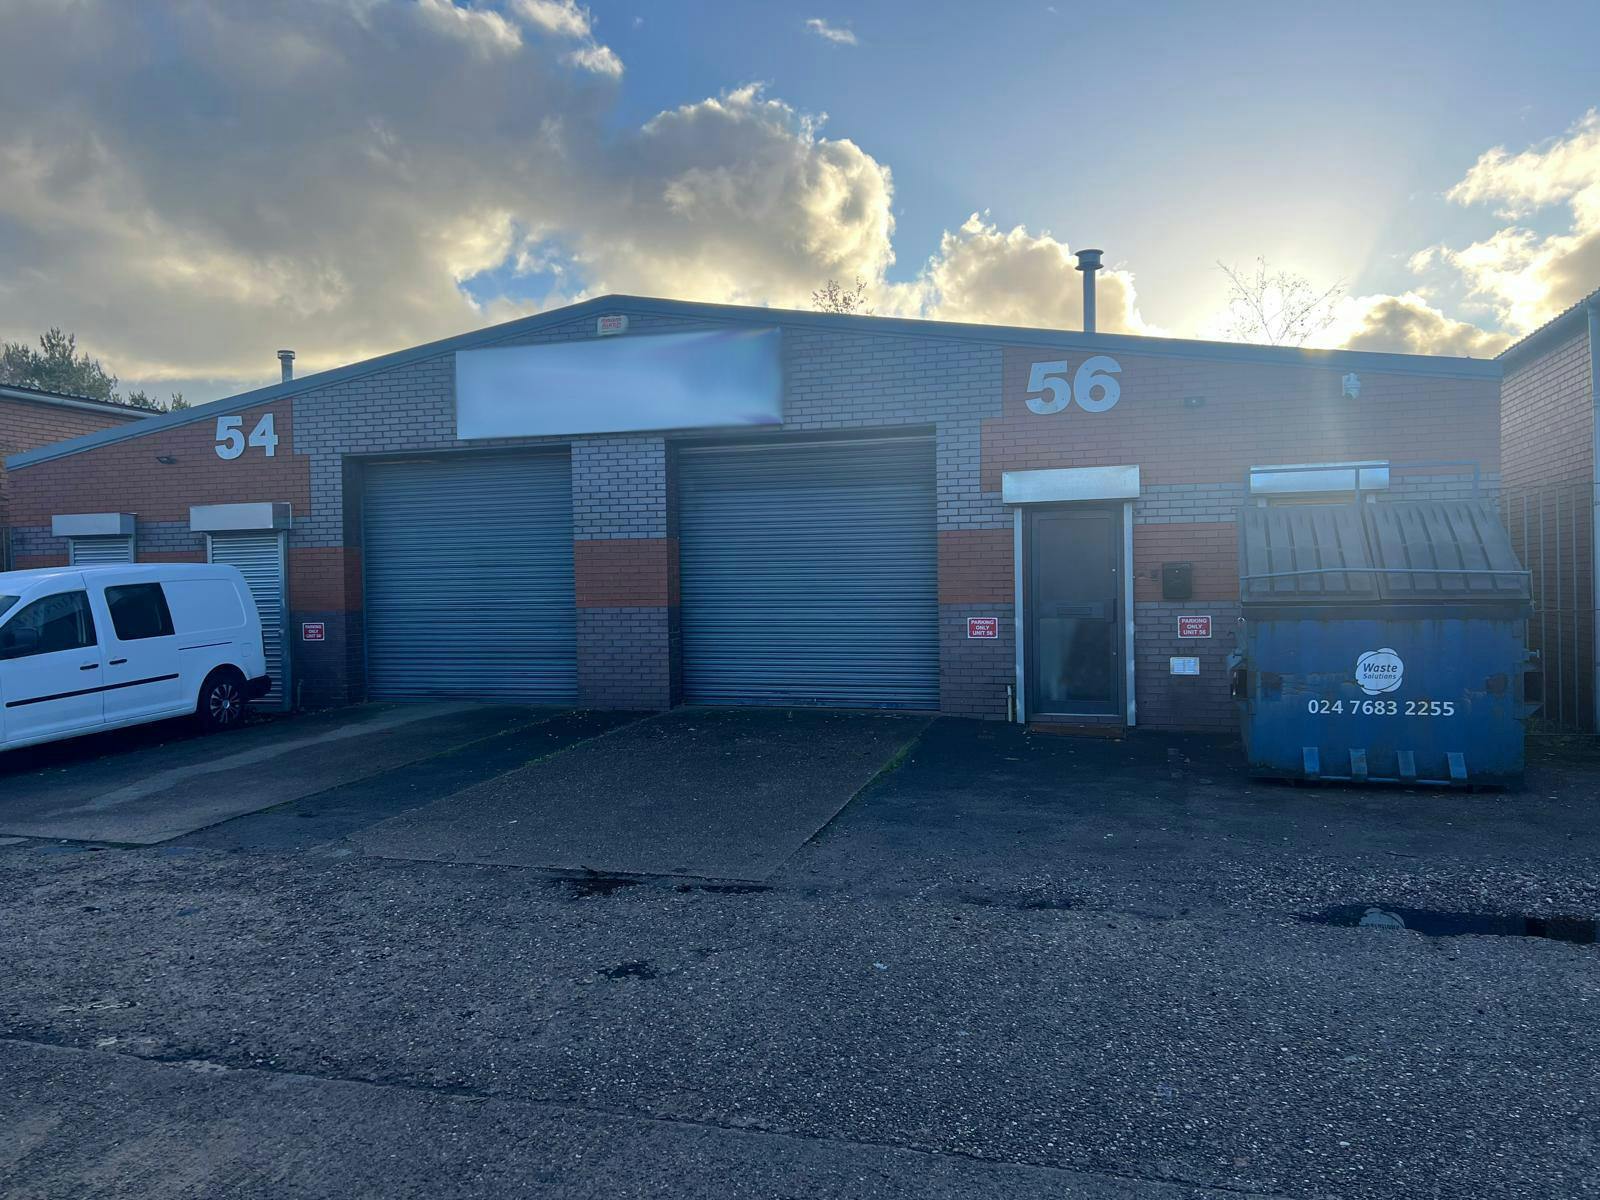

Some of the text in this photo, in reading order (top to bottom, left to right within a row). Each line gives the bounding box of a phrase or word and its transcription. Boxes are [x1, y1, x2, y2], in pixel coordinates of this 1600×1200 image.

[1024, 355, 1122, 415] 56
[215, 413, 279, 460] 54
[1363, 663, 1398, 673] Waste
[1308, 699, 1455, 716] 024 7683 2255
